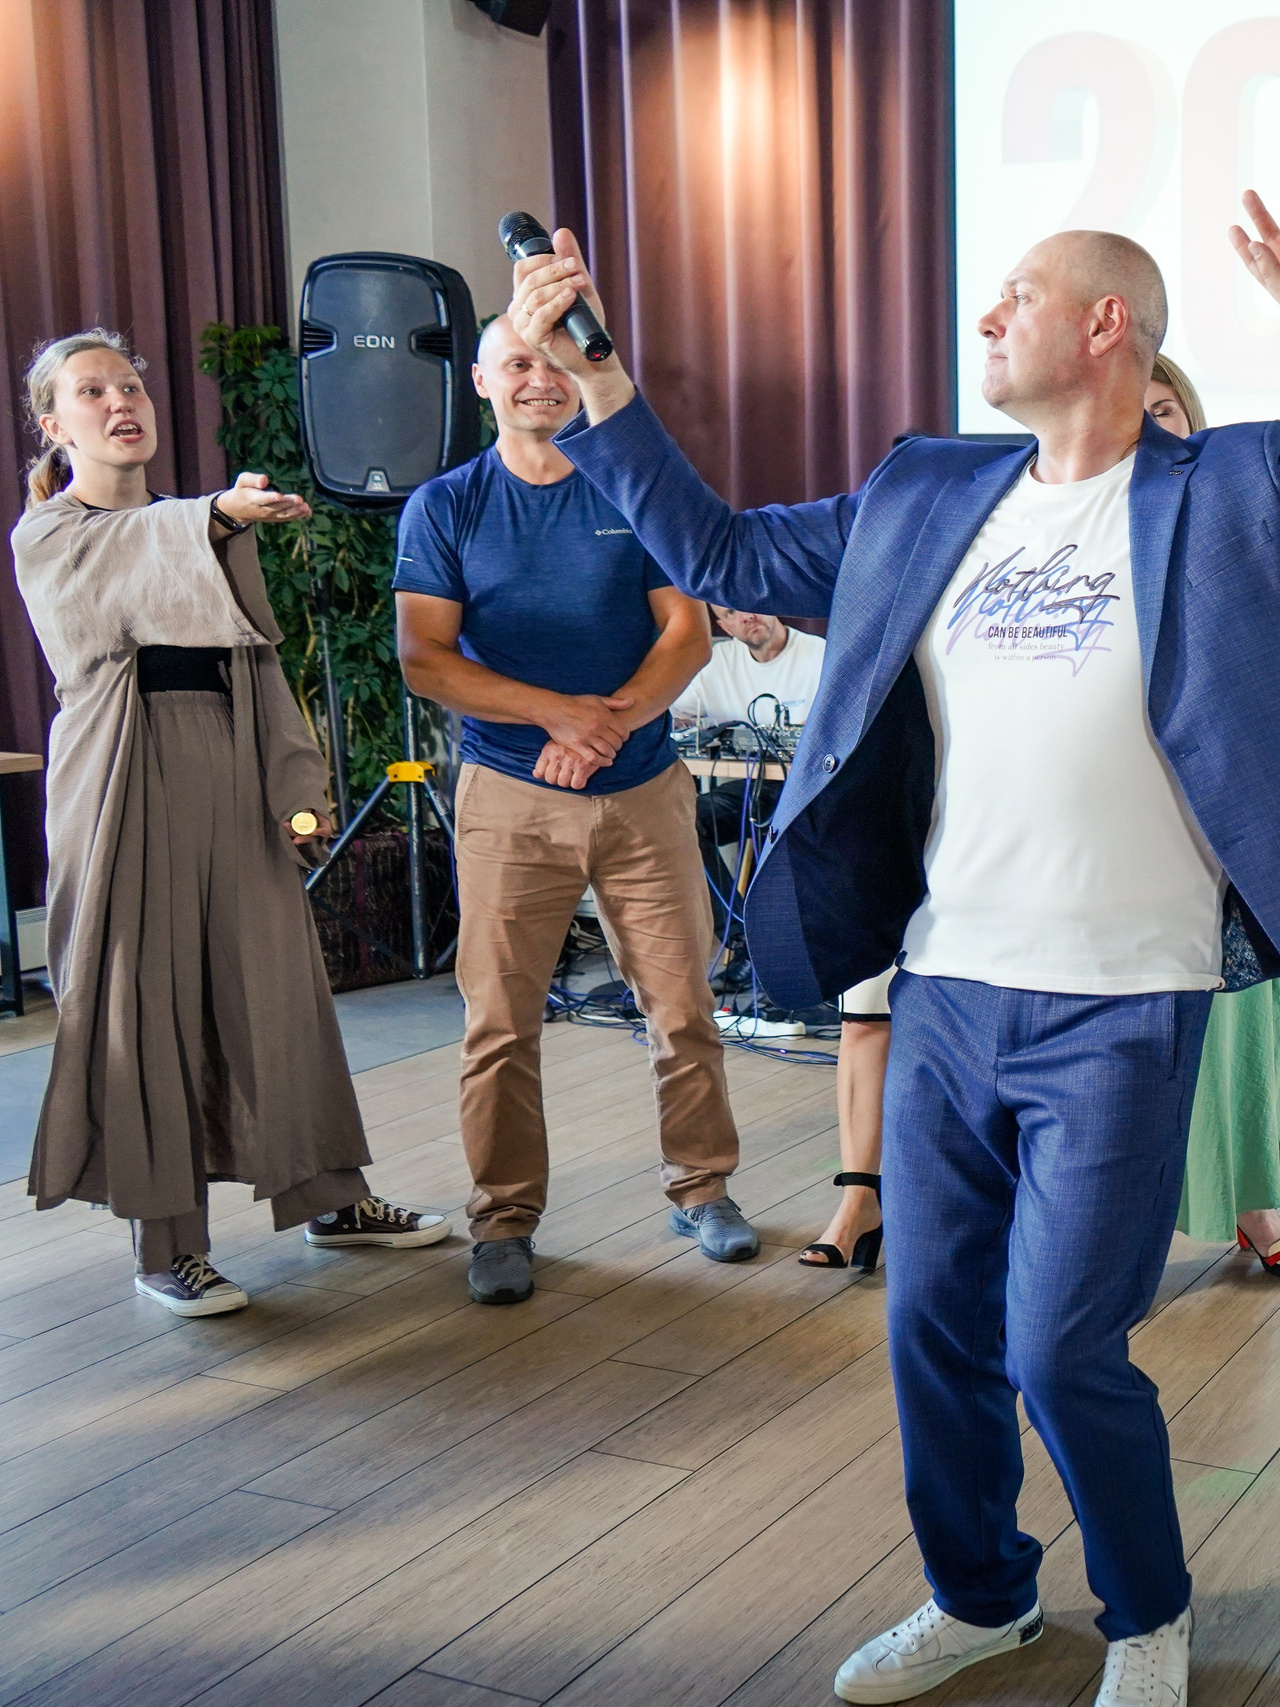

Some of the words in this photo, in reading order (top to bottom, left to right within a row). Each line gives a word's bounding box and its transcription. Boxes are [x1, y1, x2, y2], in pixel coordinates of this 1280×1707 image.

[353, 334, 395, 349] EON
[953, 544, 1121, 624] Nothing
[988, 625, 1007, 638] CAN
[1008, 626, 1020, 639] BE
[1021, 625, 1068, 639] BEAUTIFUL
[988, 641, 1006, 650] from
[1020, 642, 1038, 651] sides
[1039, 642, 1065, 652] beauty
